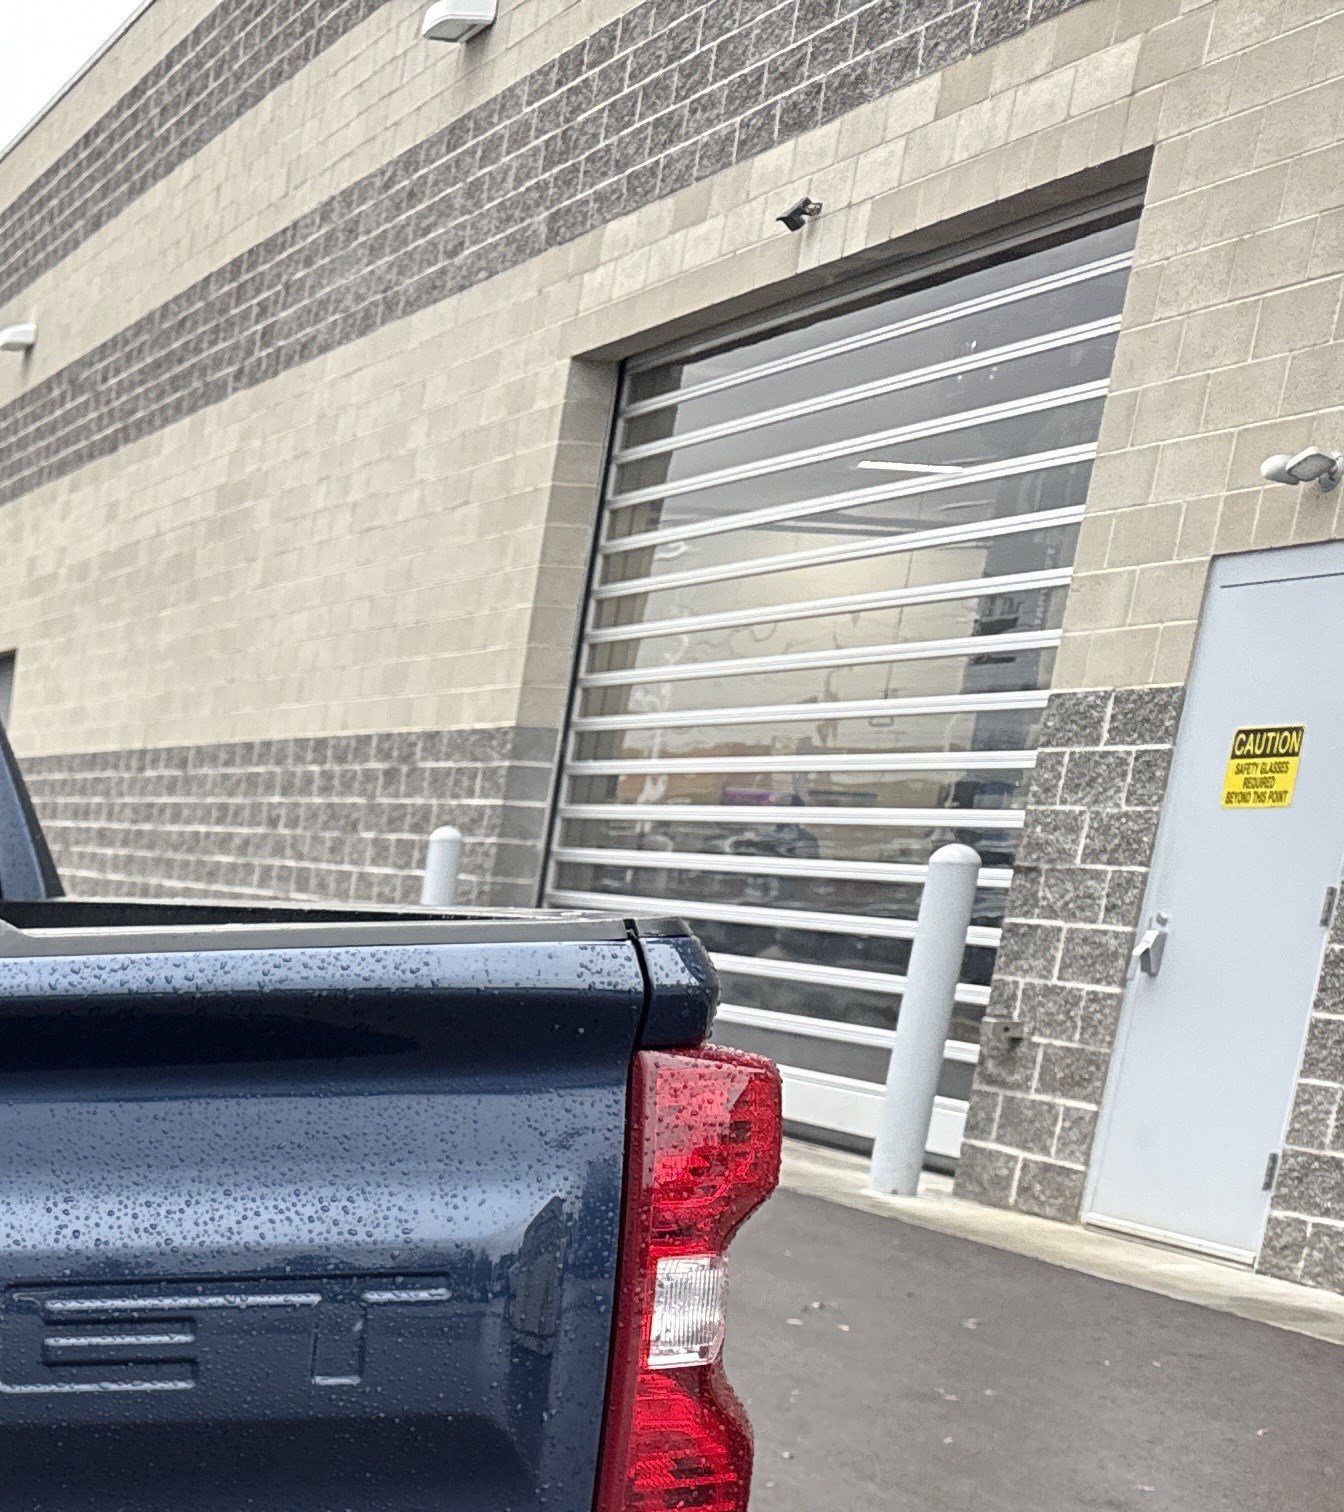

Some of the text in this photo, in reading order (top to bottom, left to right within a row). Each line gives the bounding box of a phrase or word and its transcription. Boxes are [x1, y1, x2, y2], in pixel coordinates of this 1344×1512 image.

[1234, 730, 1303, 755] CAUTION
[1235, 761, 1291, 775] SAFETY GLASSES
[1242, 776, 1276, 789] REQUIRED
[1225, 790, 1289, 804] BEYOND THIS POINT
